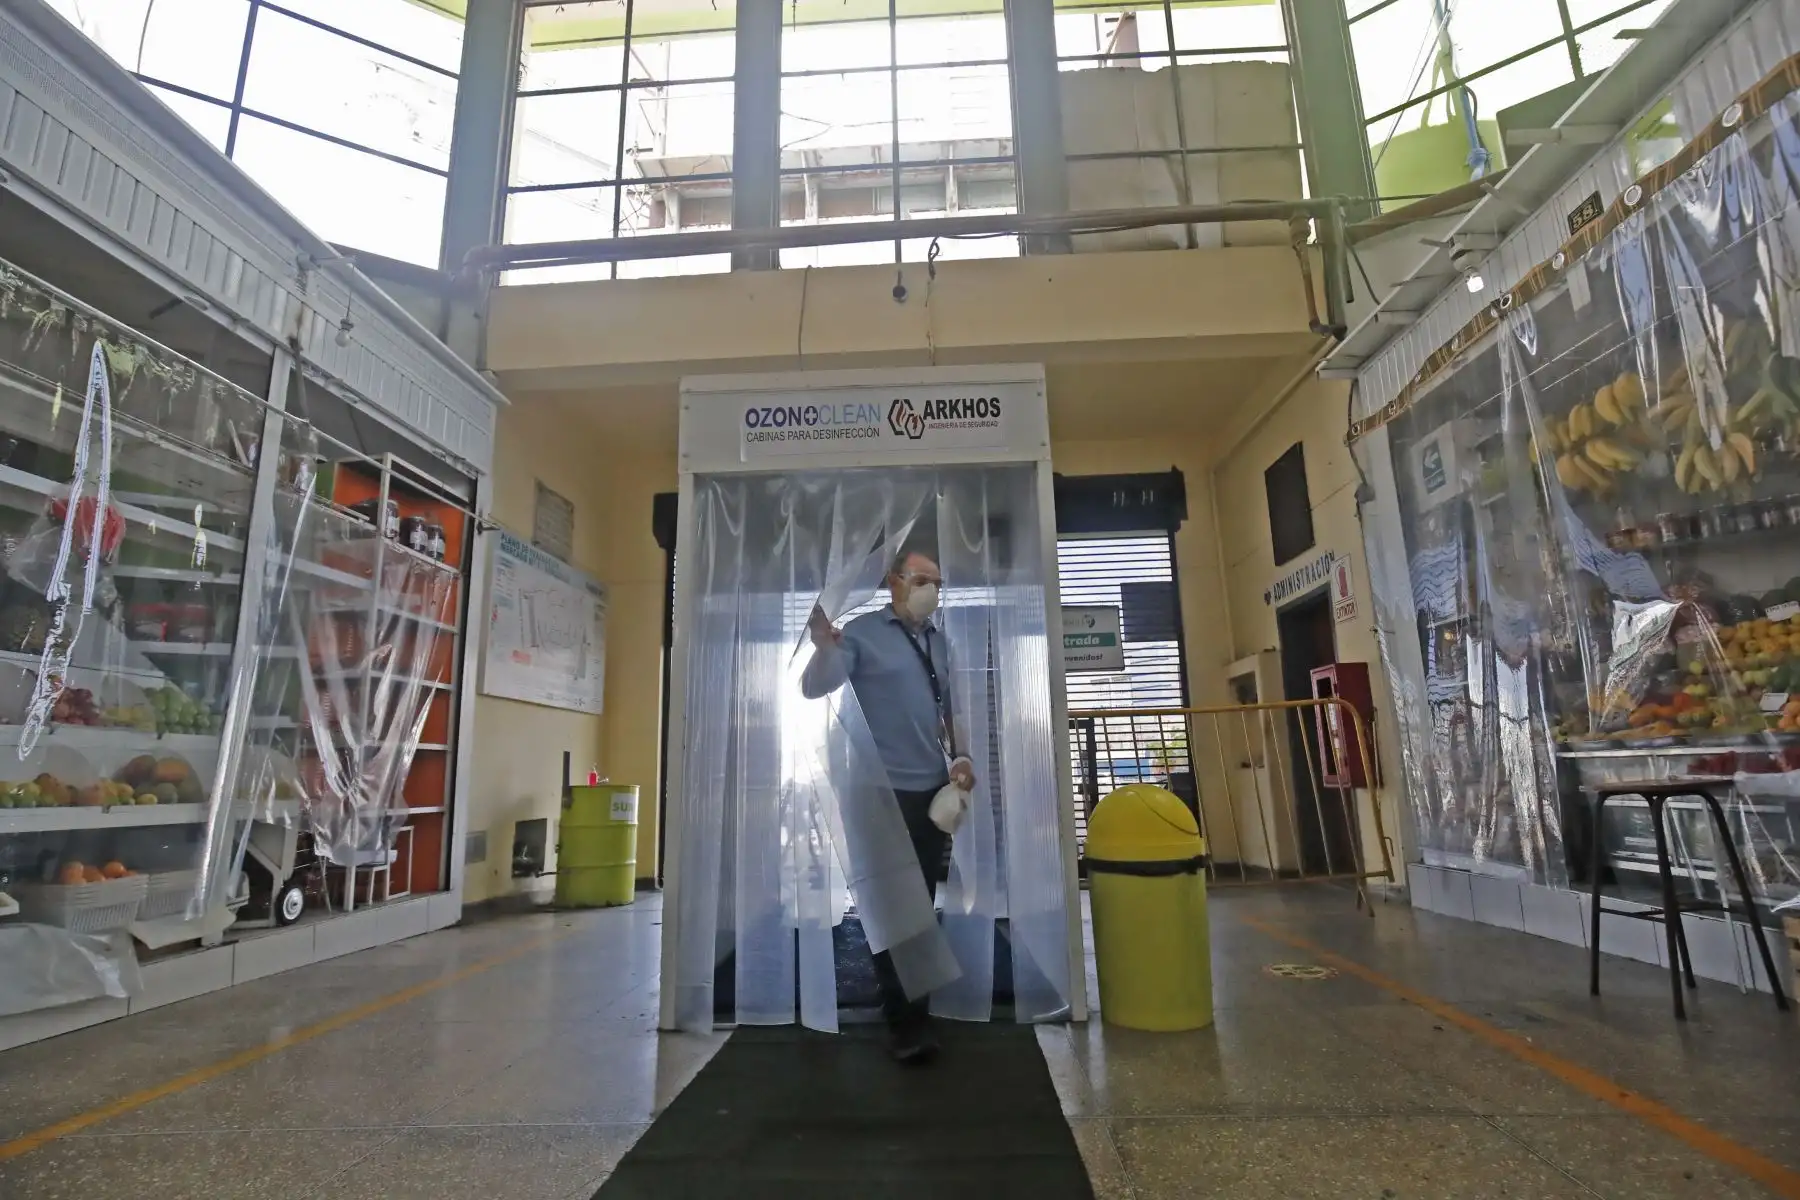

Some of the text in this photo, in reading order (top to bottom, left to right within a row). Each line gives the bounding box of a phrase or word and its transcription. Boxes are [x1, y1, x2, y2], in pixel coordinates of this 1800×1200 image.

[1572, 203, 1594, 229] 58
[923, 397, 1001, 420] ARKHOS
[746, 426, 881, 442] CABINAS PARA DESINFECCIÓN
[1064, 634, 1101, 647] trada
